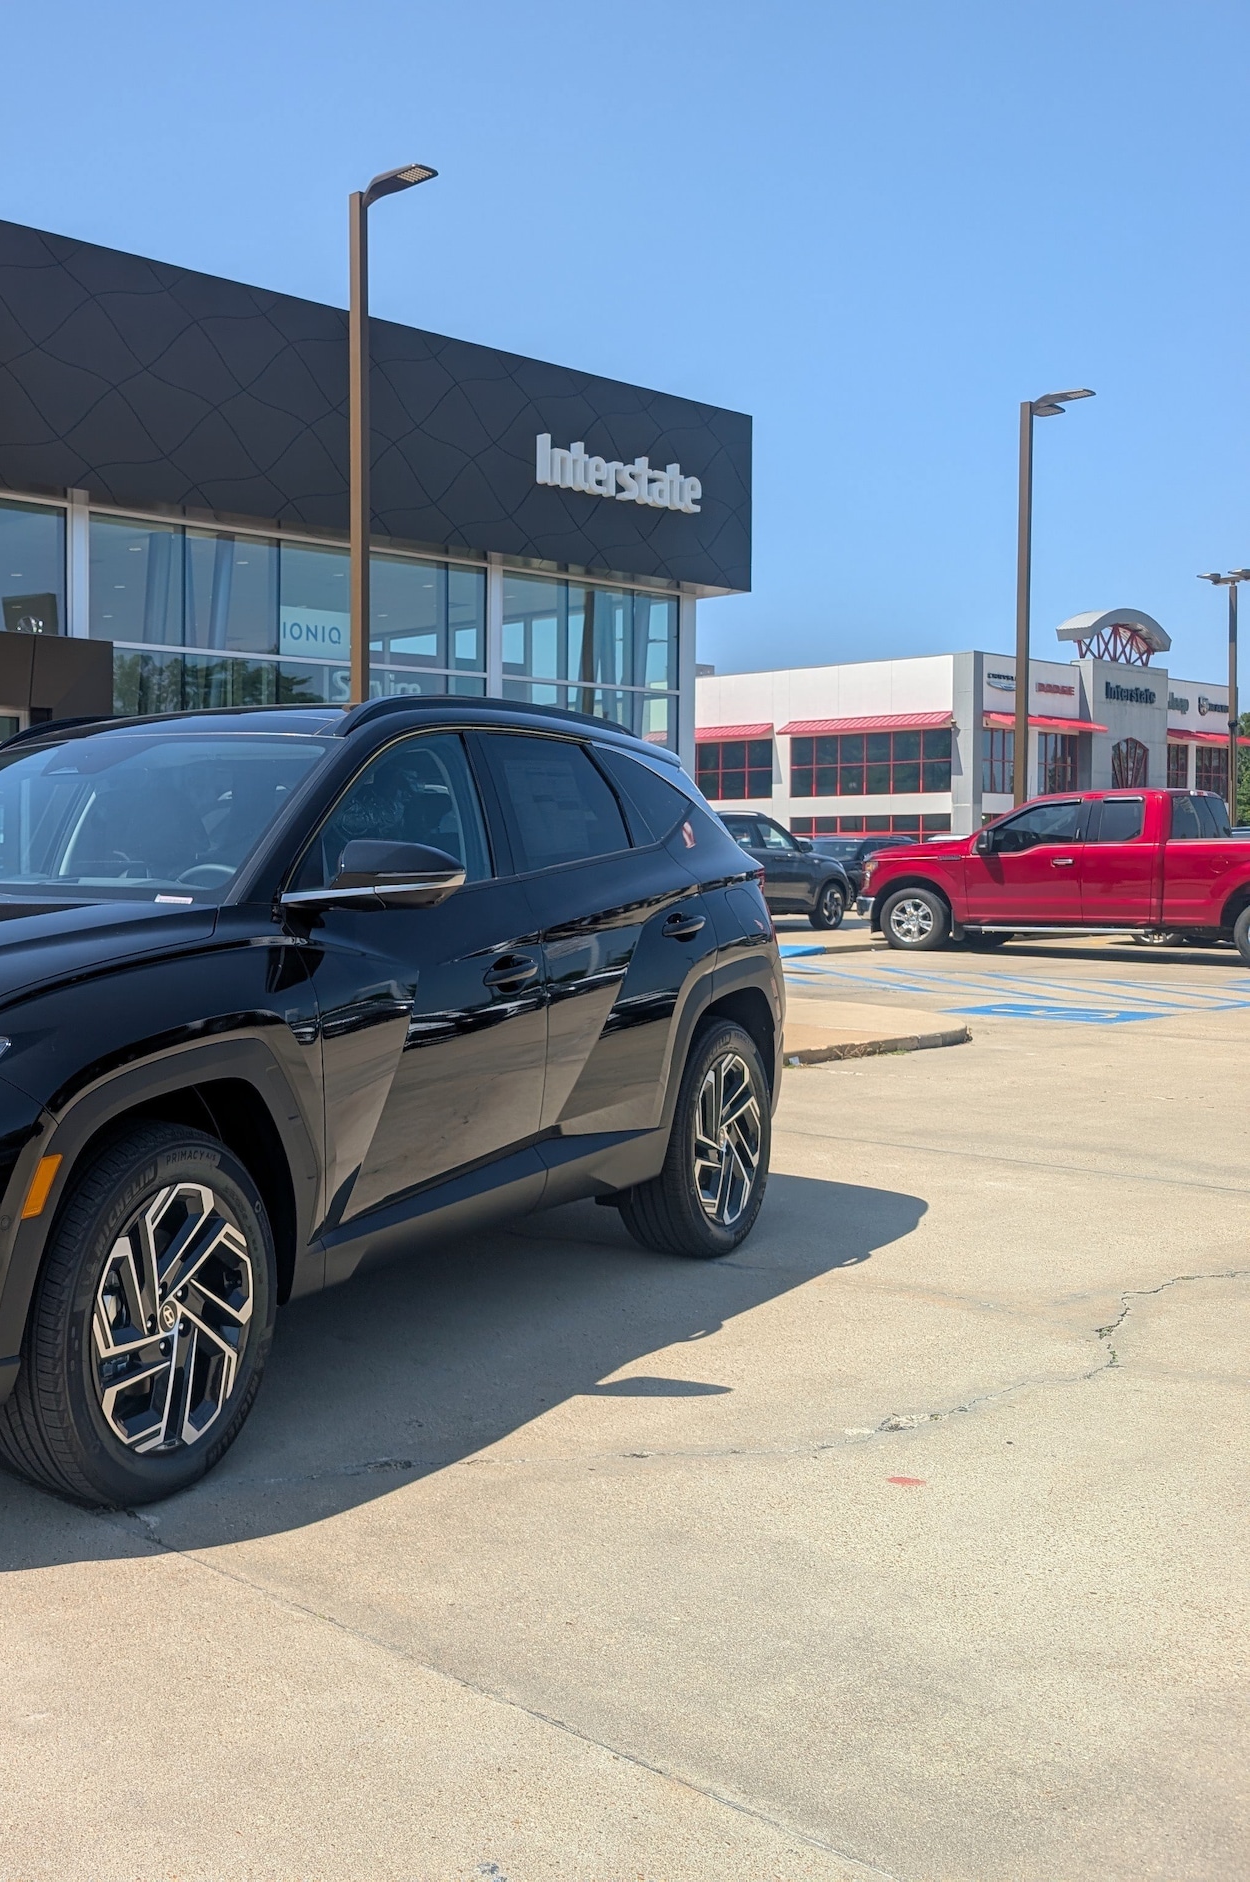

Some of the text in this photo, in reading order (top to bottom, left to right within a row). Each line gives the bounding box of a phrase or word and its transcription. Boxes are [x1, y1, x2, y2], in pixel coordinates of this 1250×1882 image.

[536, 433, 702, 514] Interstate
[282, 621, 341, 645] IONIQ
[1036, 682, 1075, 696] DODGE
[1105, 681, 1156, 705] Interstate
[166, 1149, 205, 1166] PRIMACY
[93, 1163, 156, 1258] MICHELIN
